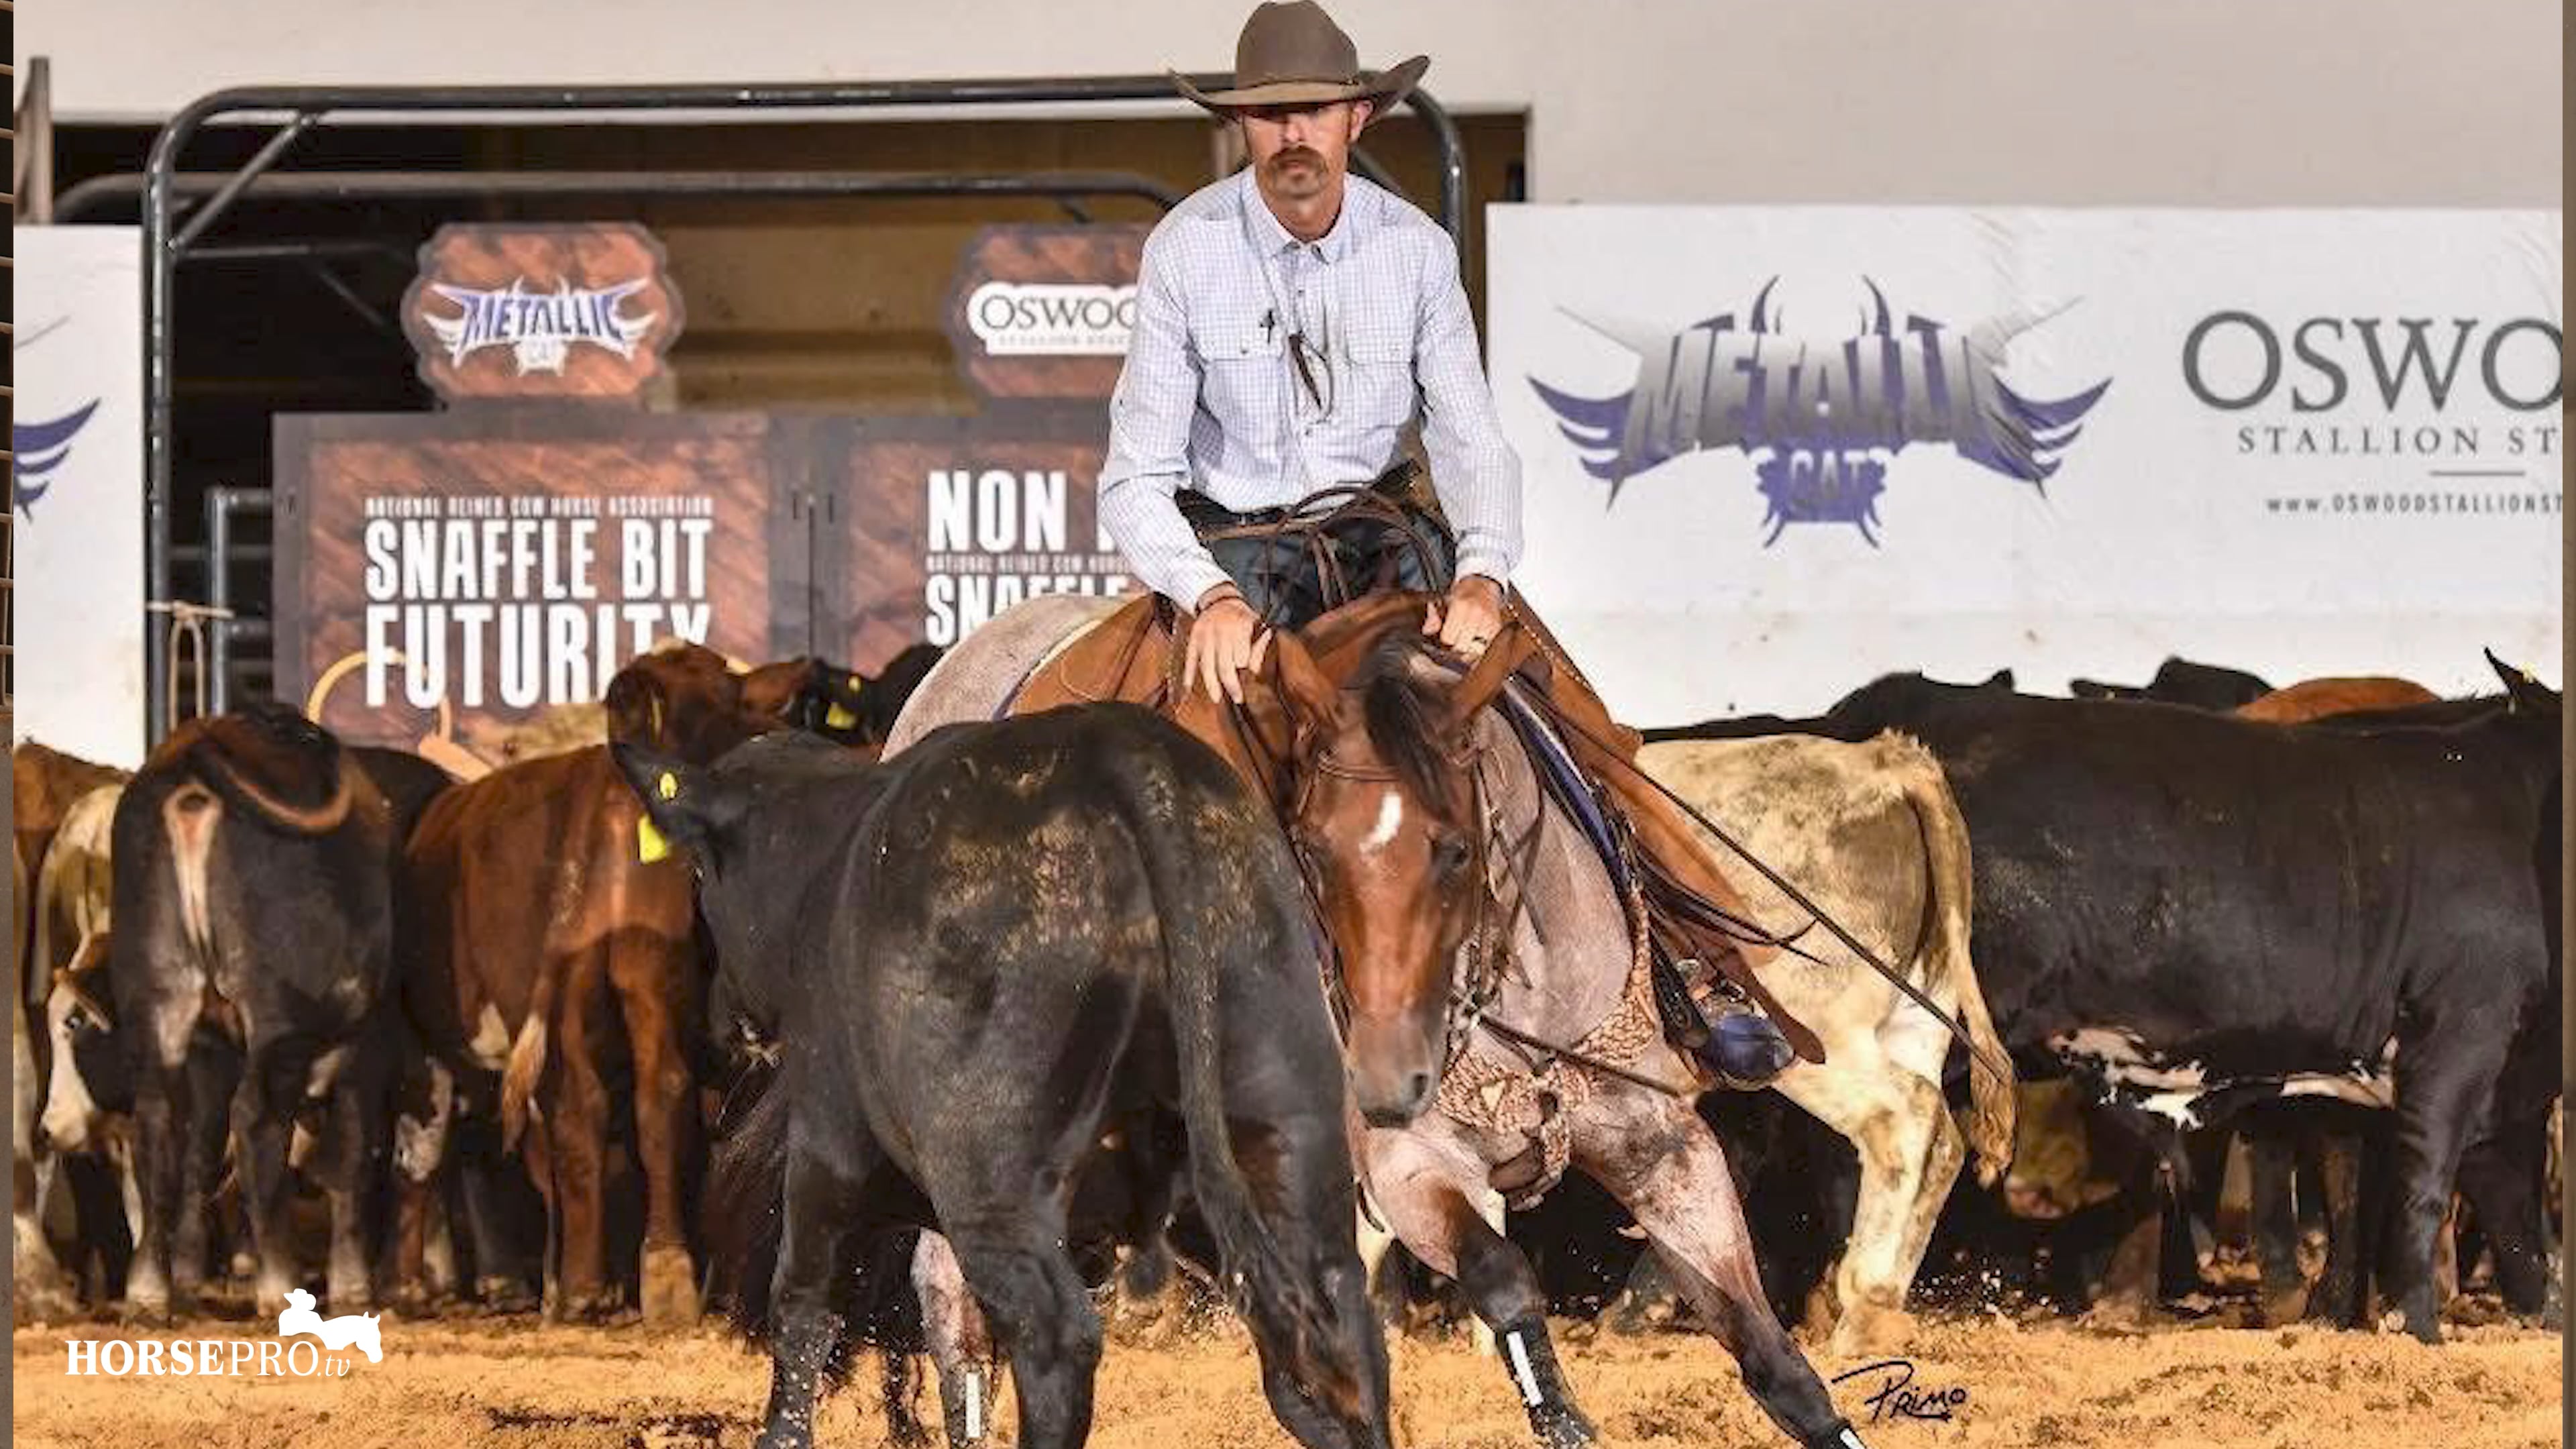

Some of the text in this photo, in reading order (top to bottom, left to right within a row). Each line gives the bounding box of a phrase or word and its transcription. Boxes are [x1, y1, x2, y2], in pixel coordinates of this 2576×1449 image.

[446, 285, 641, 349] METALLIC
[2238, 427, 2480, 454] STALLION
[927, 470, 1067, 553] NON
[1787, 448, 1870, 512] CAT
[364, 519, 712, 600] SNAFFLE BIT
